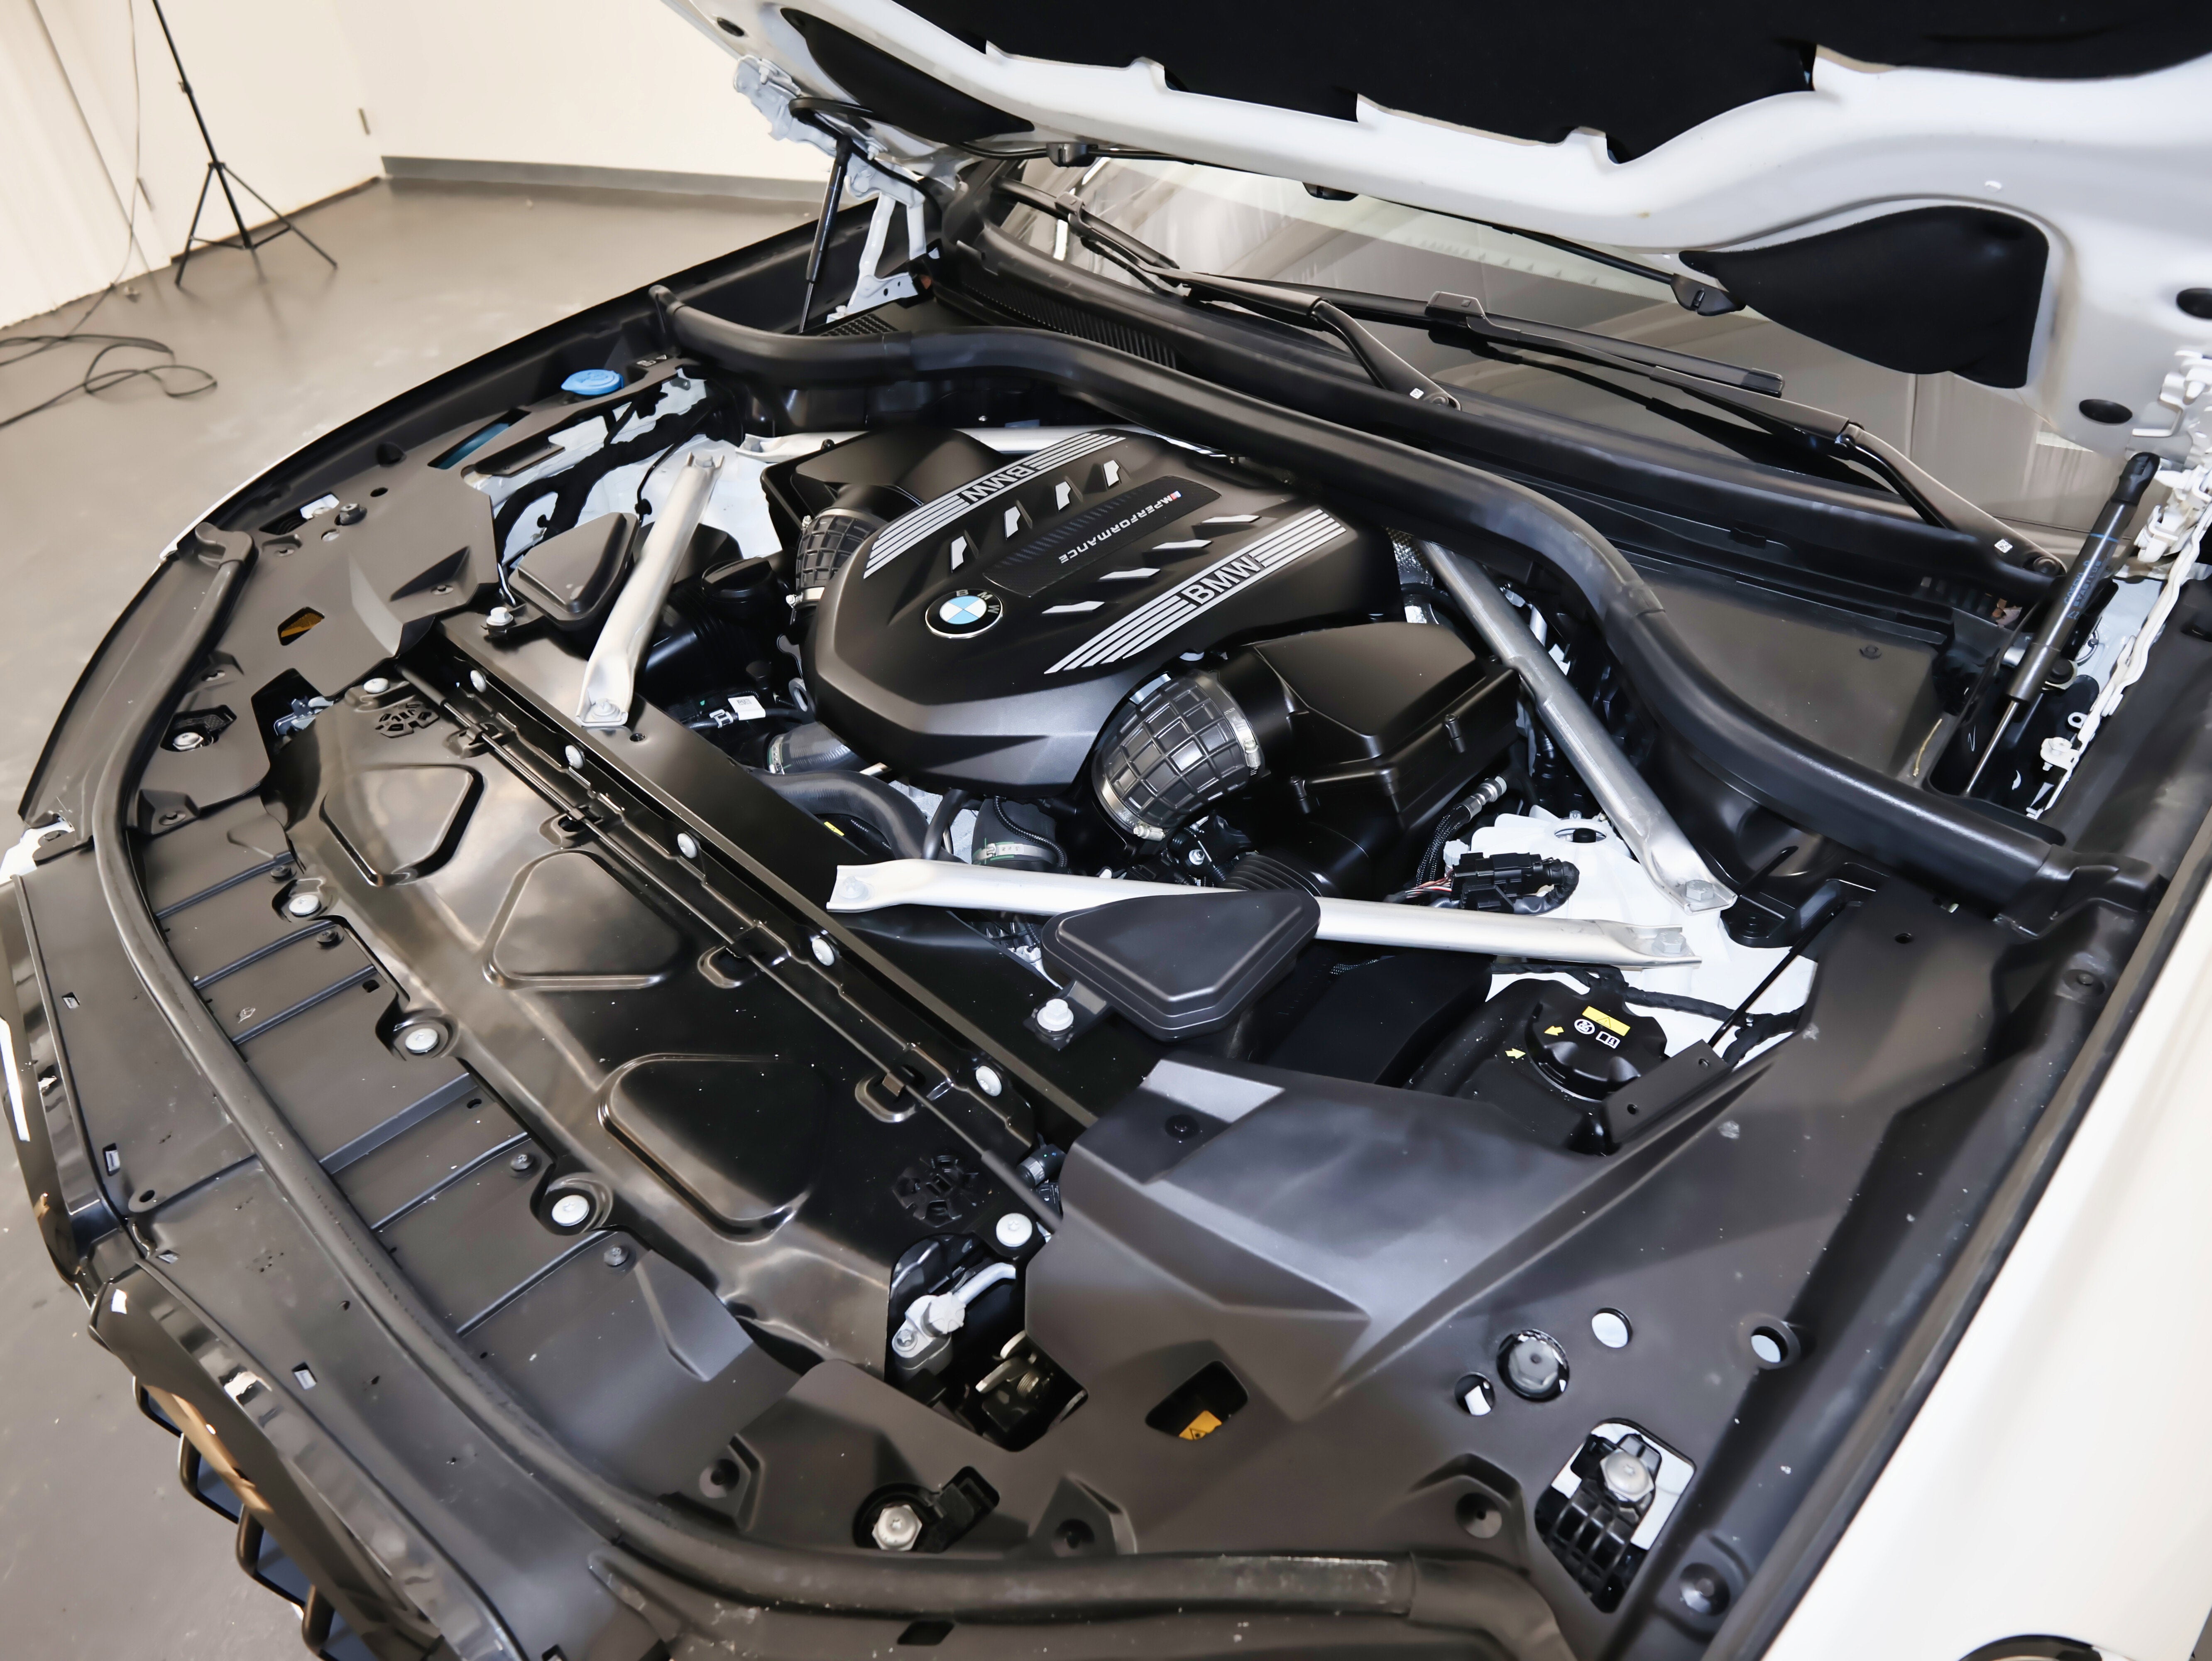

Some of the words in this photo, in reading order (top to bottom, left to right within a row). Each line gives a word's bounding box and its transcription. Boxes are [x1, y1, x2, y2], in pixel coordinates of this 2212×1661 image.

[961, 465, 1035, 502] BMW
[1181, 556, 1261, 605] BMW
[956, 589, 1000, 614] BMW
